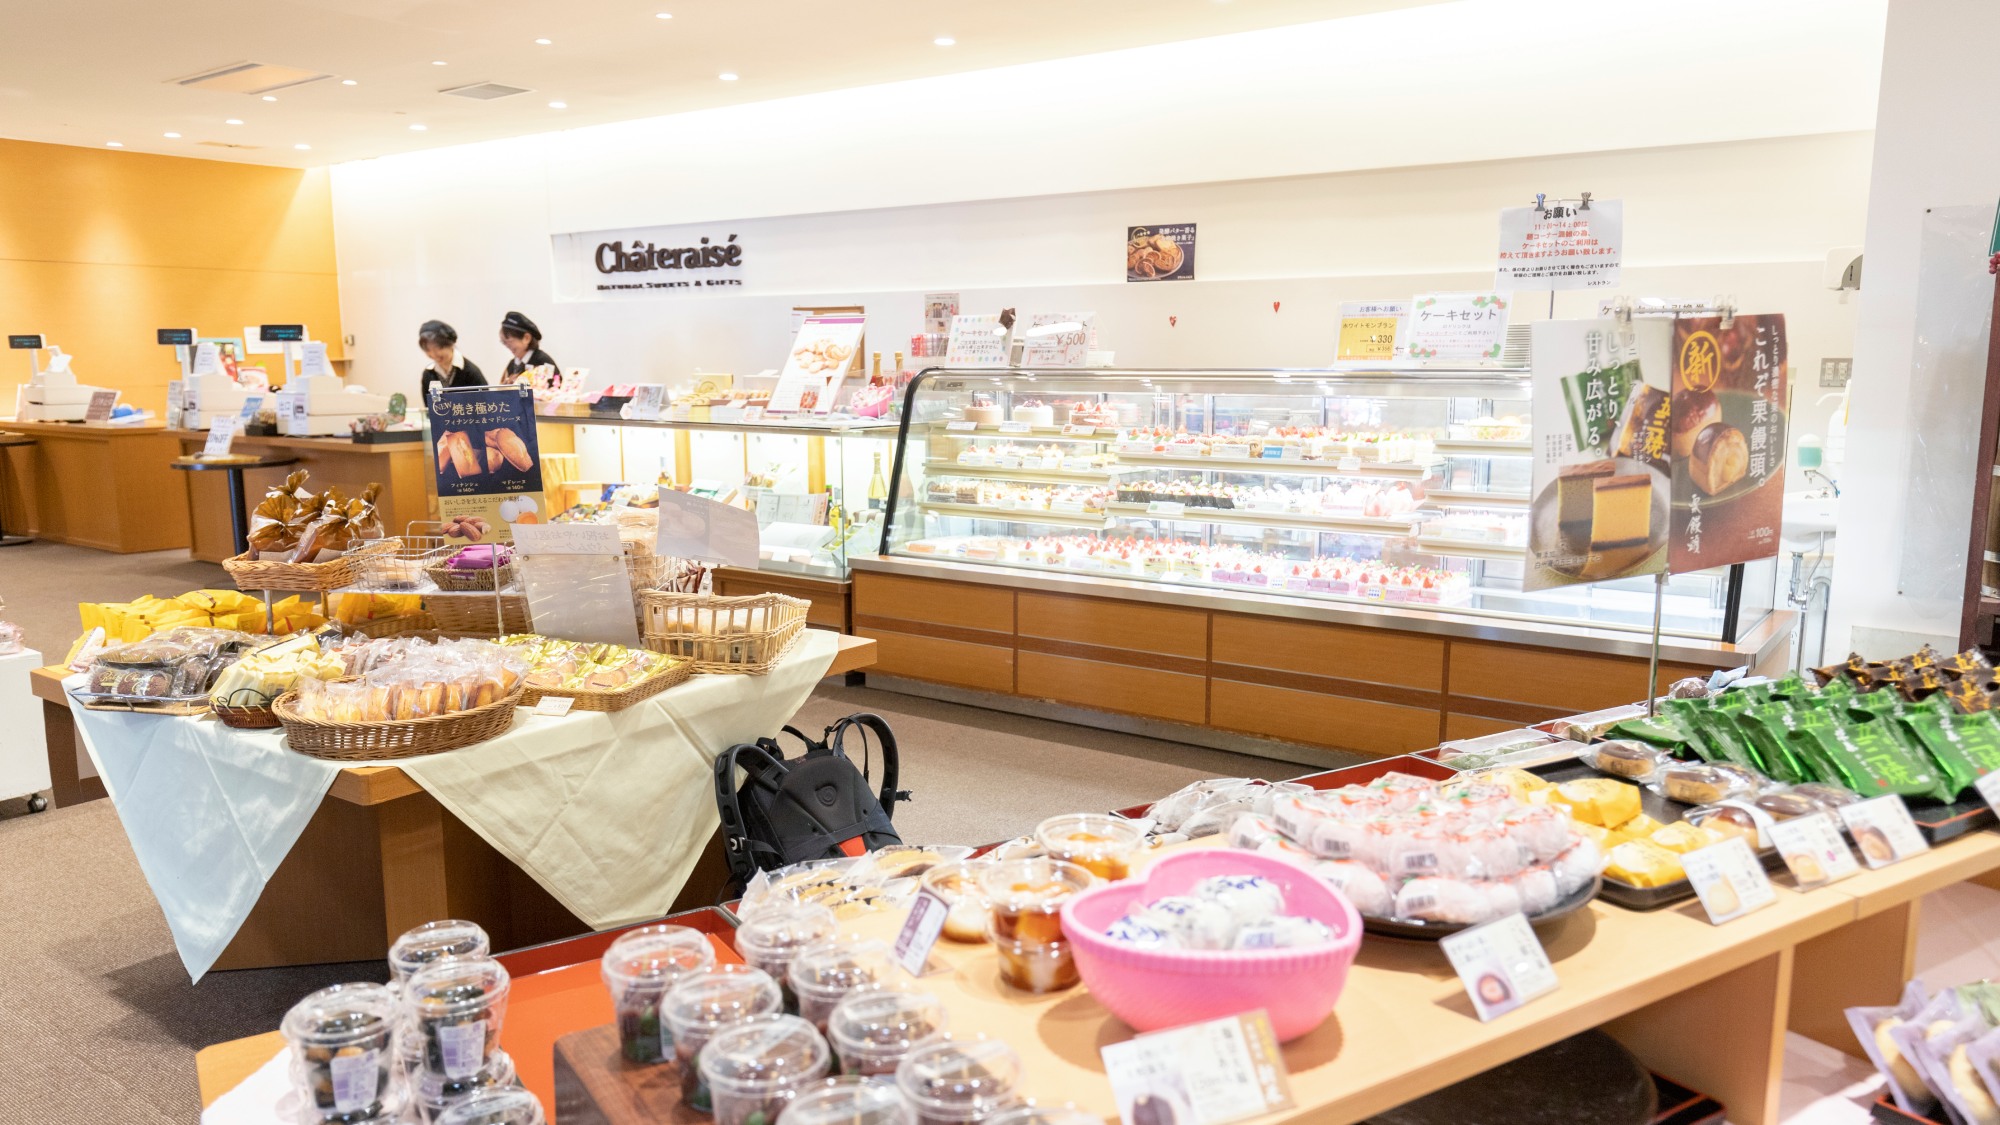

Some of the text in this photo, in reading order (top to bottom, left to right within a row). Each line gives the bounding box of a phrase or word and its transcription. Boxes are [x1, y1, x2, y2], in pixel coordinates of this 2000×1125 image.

[1543, 206, 1577, 220] お願い
[595, 234, 742, 274] Châteraisé
[694, 279, 702, 287] &
[1419, 308, 1498, 322] ケーキセット
[1342, 321, 1395, 330] ホワイトモンブラン
[1685, 339, 1714, 384] 新
[1585, 332, 1604, 458] 甘み広がる。
[434, 401, 453, 412] NEW
[452, 401, 511, 416] 焼き極めた
[1749, 326, 1769, 487] これぞ栗饅頭。
